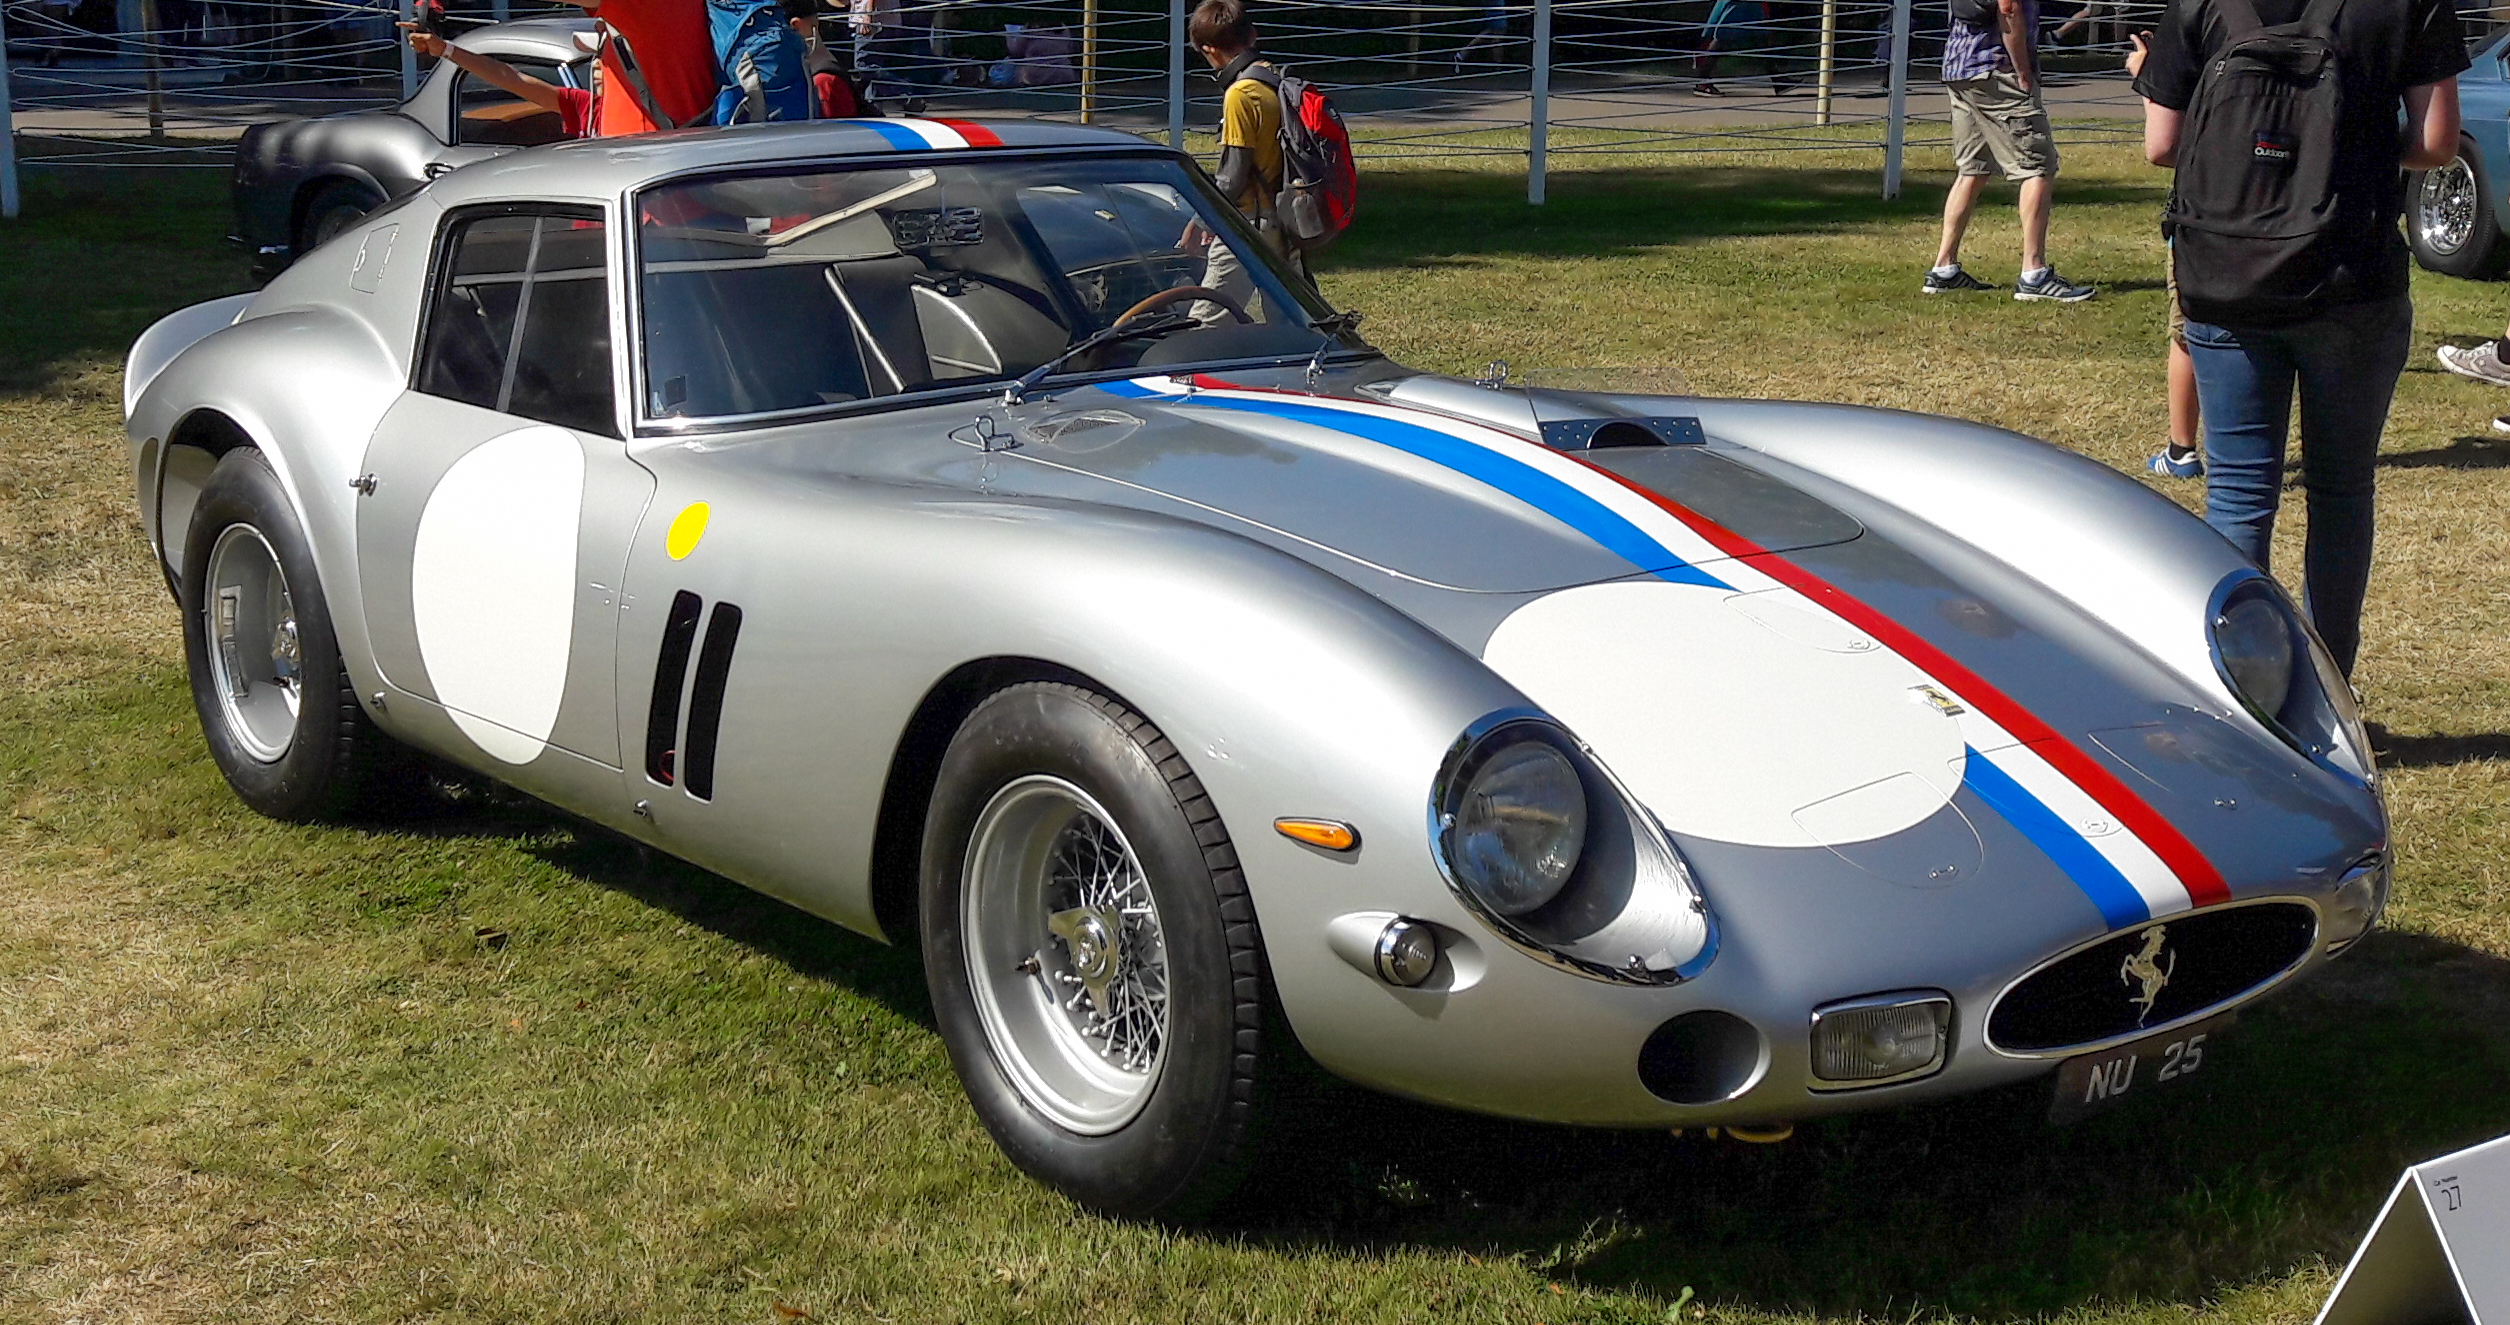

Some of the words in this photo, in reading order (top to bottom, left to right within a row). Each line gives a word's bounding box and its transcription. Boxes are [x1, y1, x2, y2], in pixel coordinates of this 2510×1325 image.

[2085, 1054, 2138, 1103] NU
[2159, 1033, 2207, 1082] 25
[2441, 1185, 2461, 1211] 27
